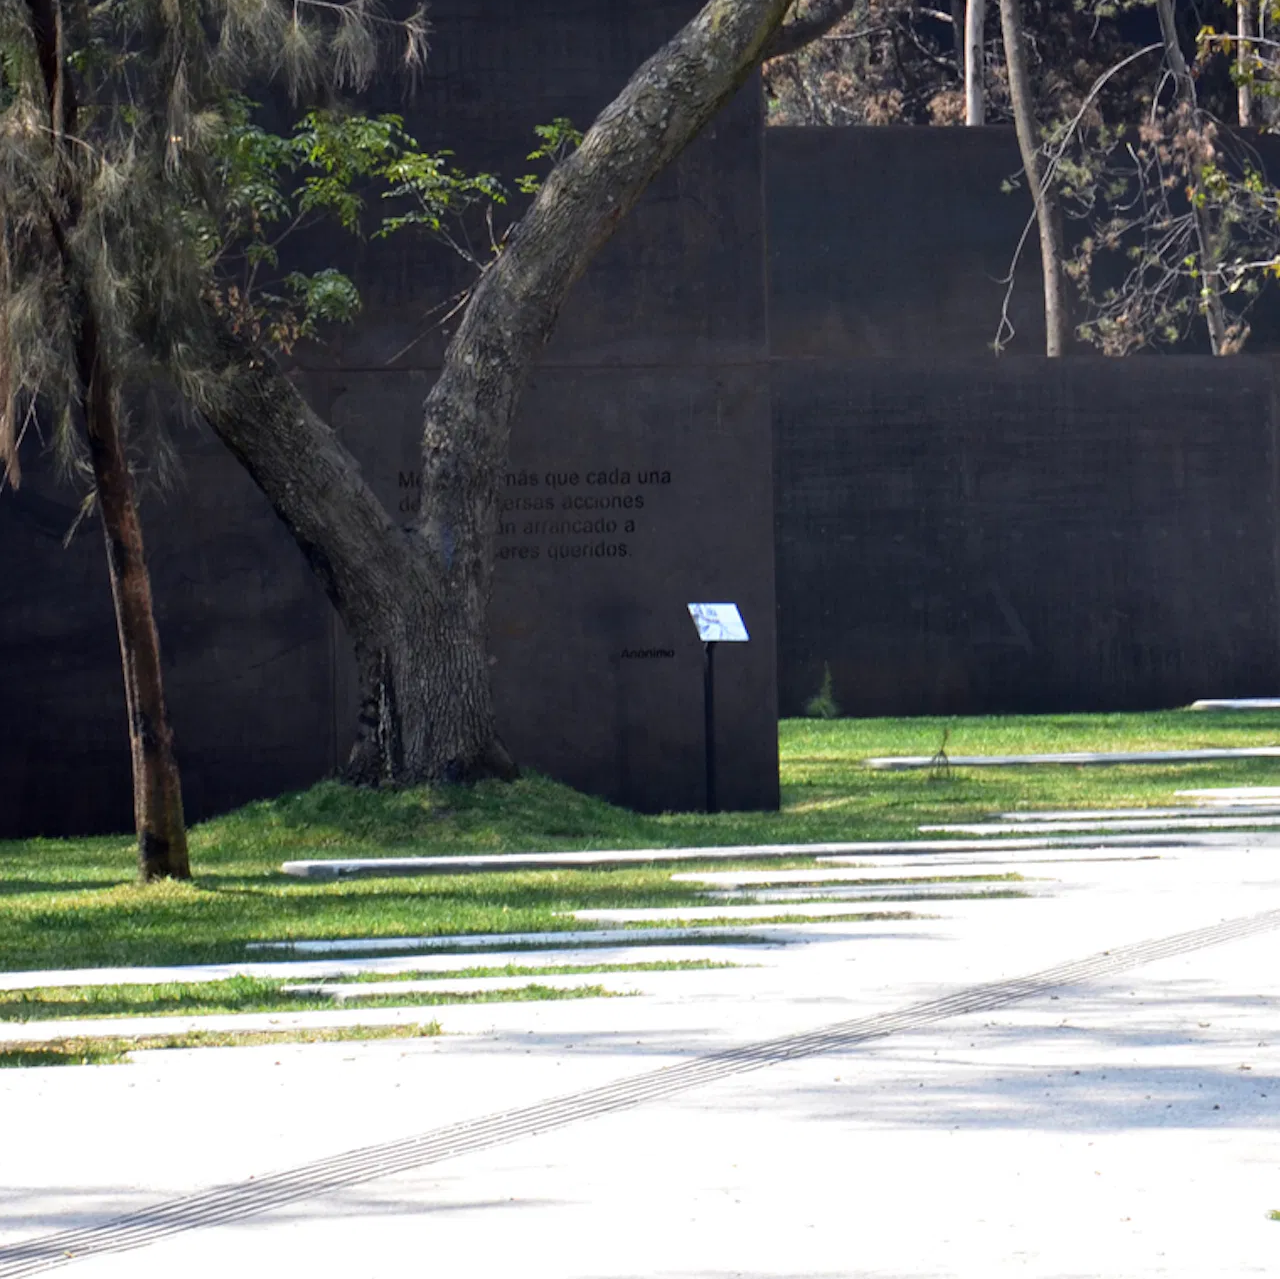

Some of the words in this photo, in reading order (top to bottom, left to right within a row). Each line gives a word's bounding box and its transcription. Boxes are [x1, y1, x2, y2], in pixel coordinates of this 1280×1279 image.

[545, 471, 580, 490] que
[586, 468, 631, 486] cada
[637, 469, 672, 485] una
[561, 493, 645, 510] acciones
[523, 517, 617, 535] arrancado
[624, 519, 636, 533] a
[548, 541, 632, 561] queridos.
